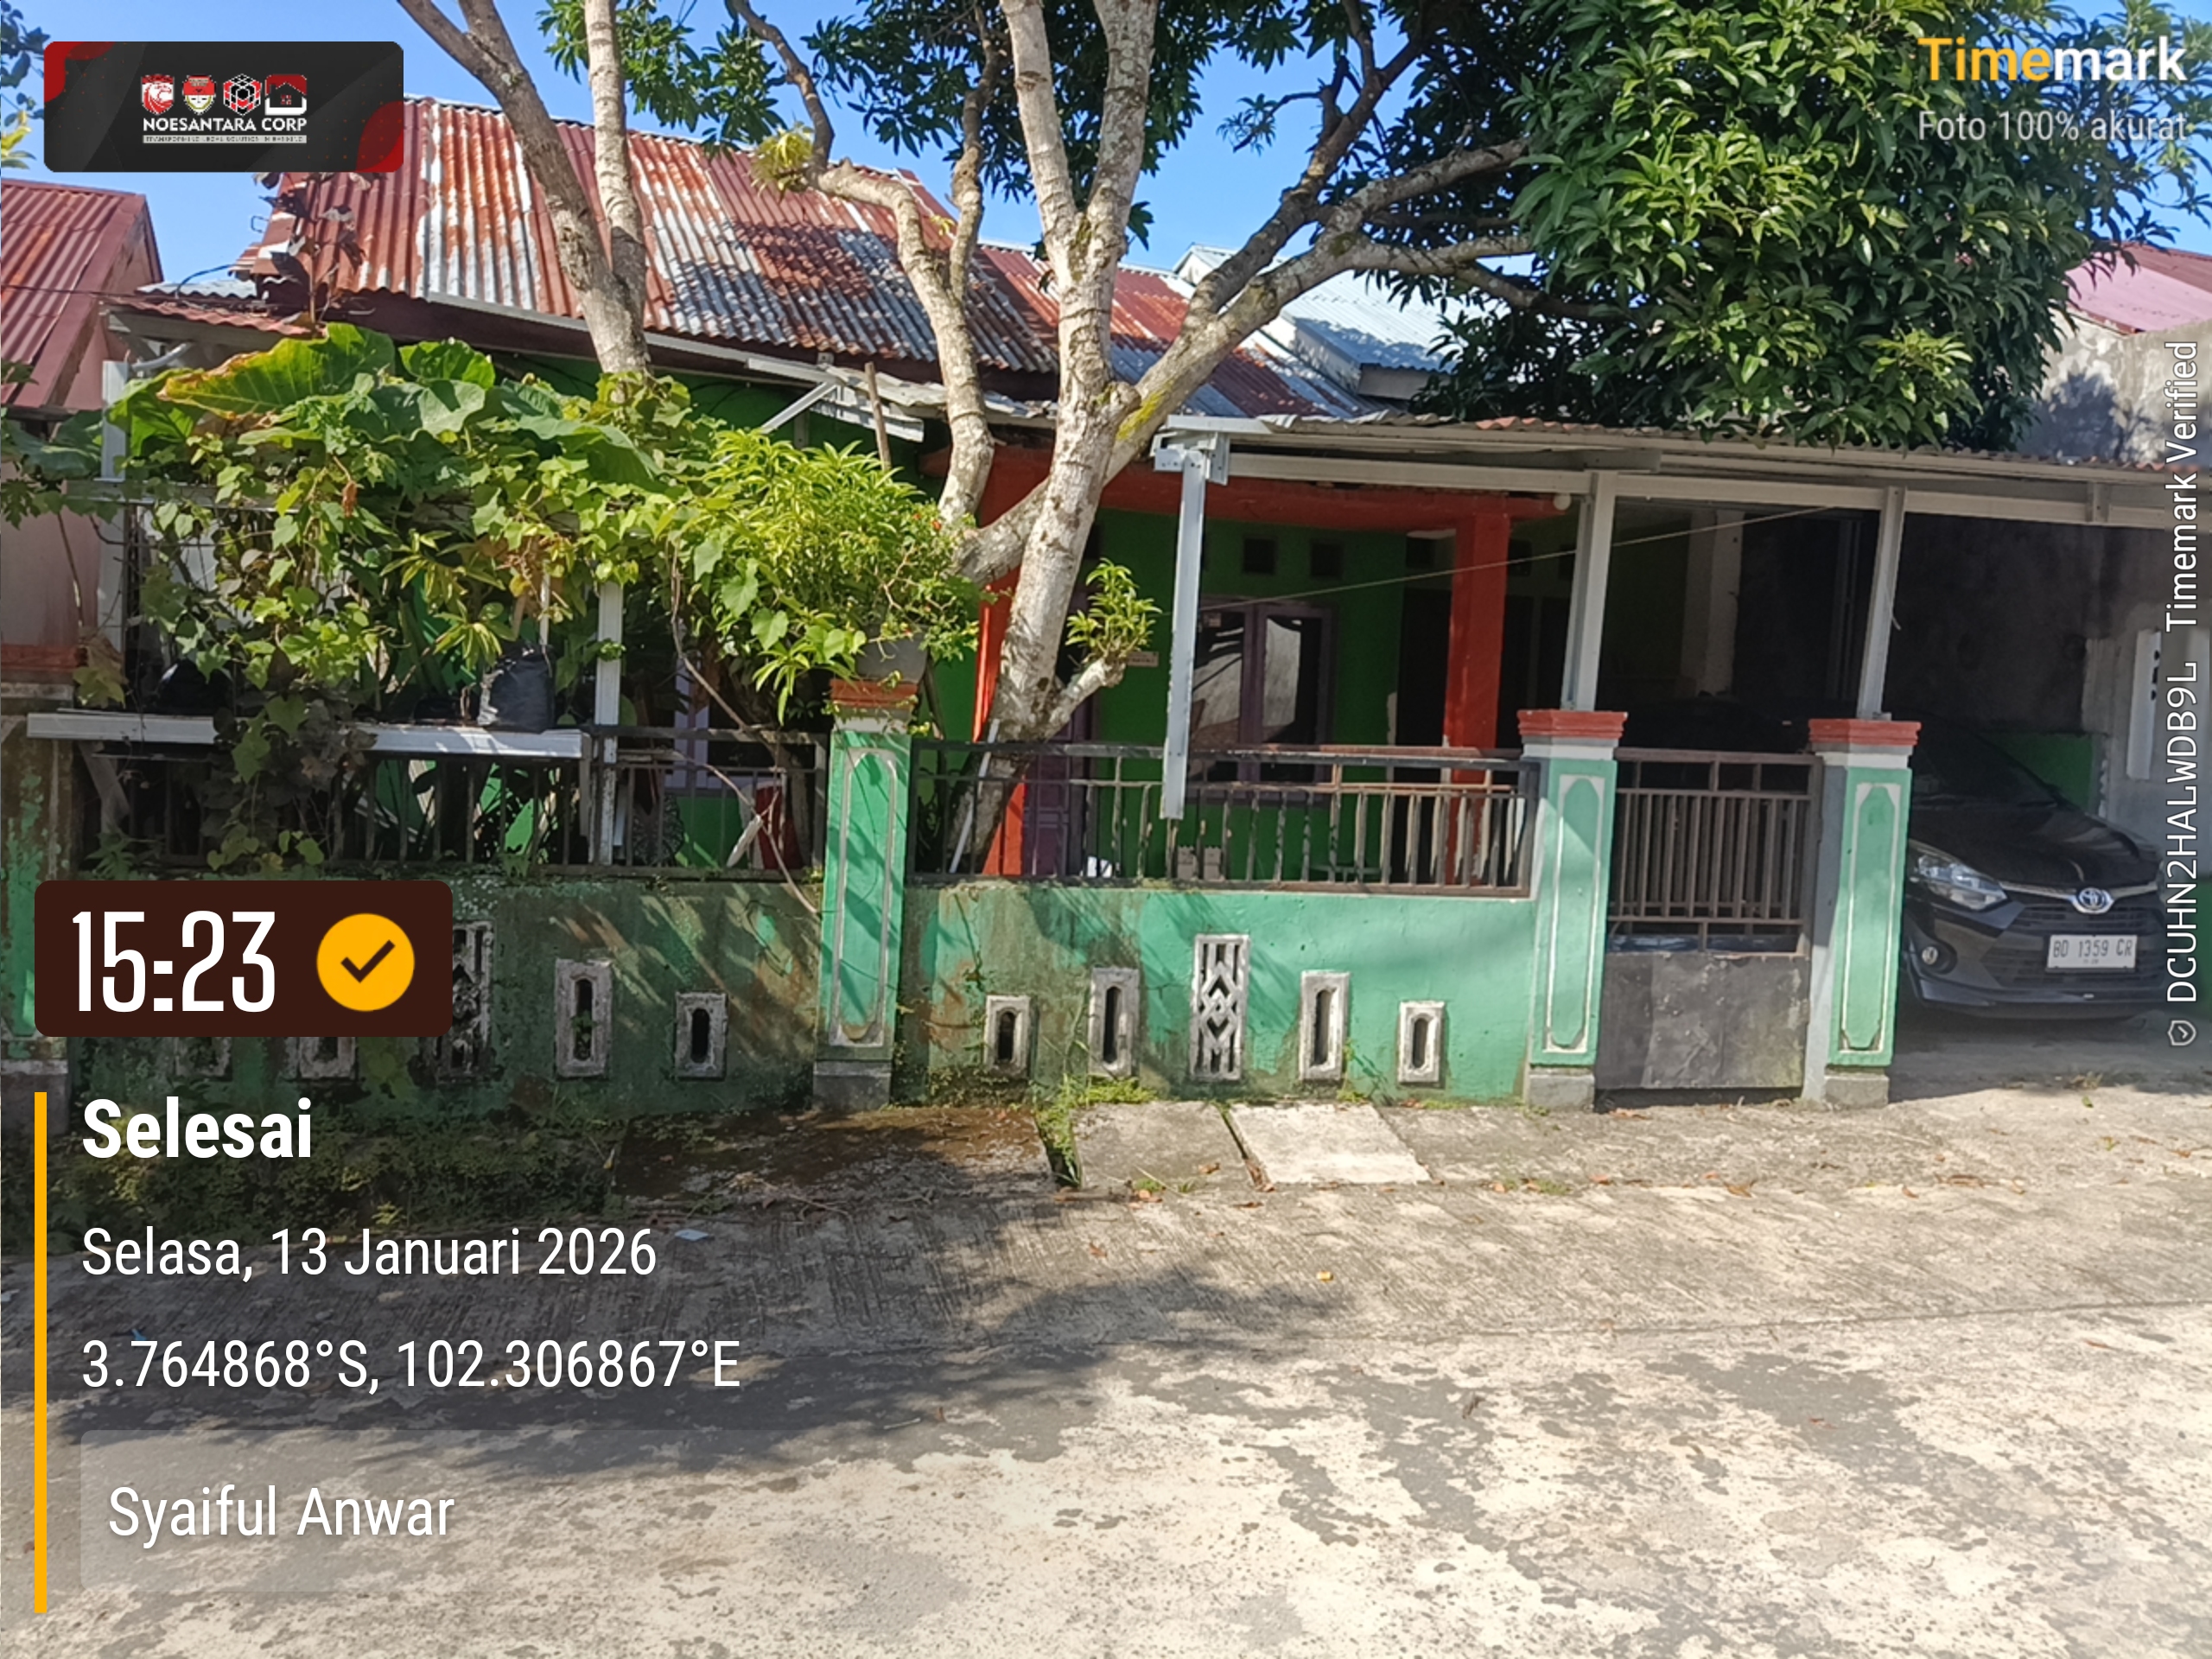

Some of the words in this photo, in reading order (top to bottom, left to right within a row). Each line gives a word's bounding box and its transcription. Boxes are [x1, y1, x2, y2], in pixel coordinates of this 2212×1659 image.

[2053, 939, 2069, 958] BD
[2078, 939, 2109, 958] 1359
[2116, 938, 2133, 957] CR
